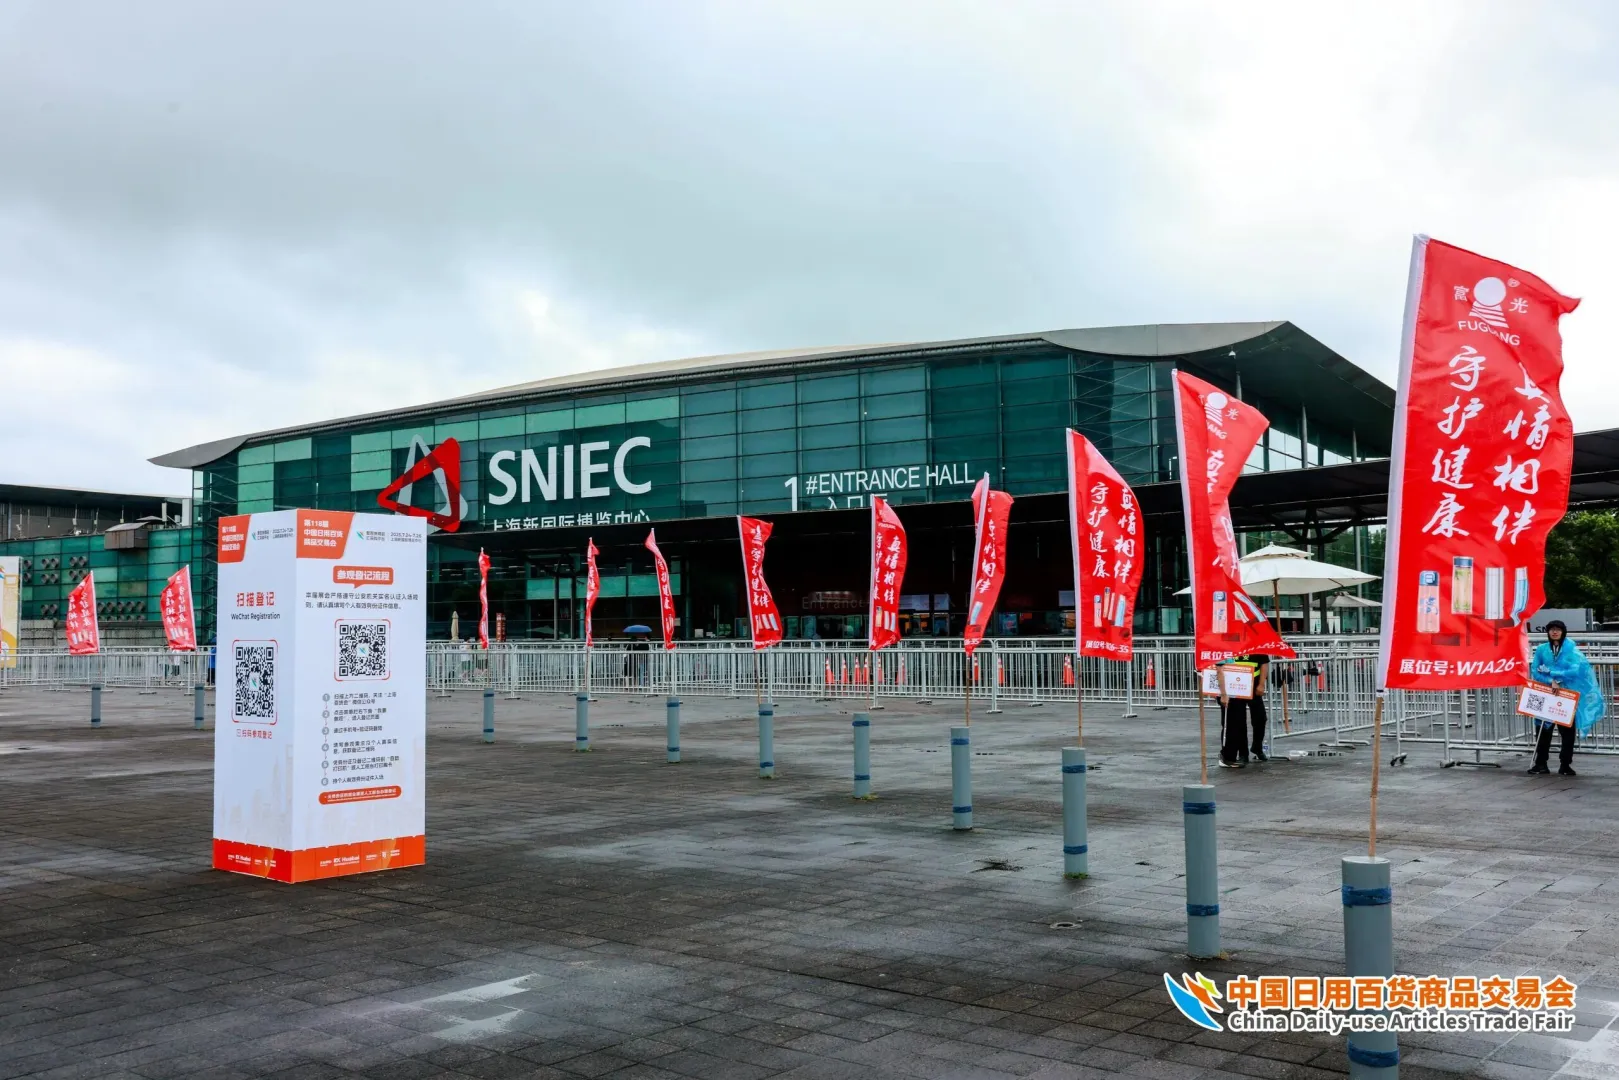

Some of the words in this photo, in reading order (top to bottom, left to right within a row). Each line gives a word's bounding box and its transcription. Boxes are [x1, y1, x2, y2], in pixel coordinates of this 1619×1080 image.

[1453, 285, 1470, 302] 富
[1508, 297, 1529, 314] 光
[1457, 320, 1521, 346] FUGUNG
[488, 436, 652, 506] SNIEC
[805, 466, 921, 495] #ENTRANCE
[925, 462, 976, 487] HALL
[1114, 487, 1136, 584] 真情相伴
[336, 569, 391, 581] 参观登记流程
[236, 591, 275, 607] 扫描登记
[230, 612, 250, 621] WeChat
[250, 612, 281, 622] Registration
